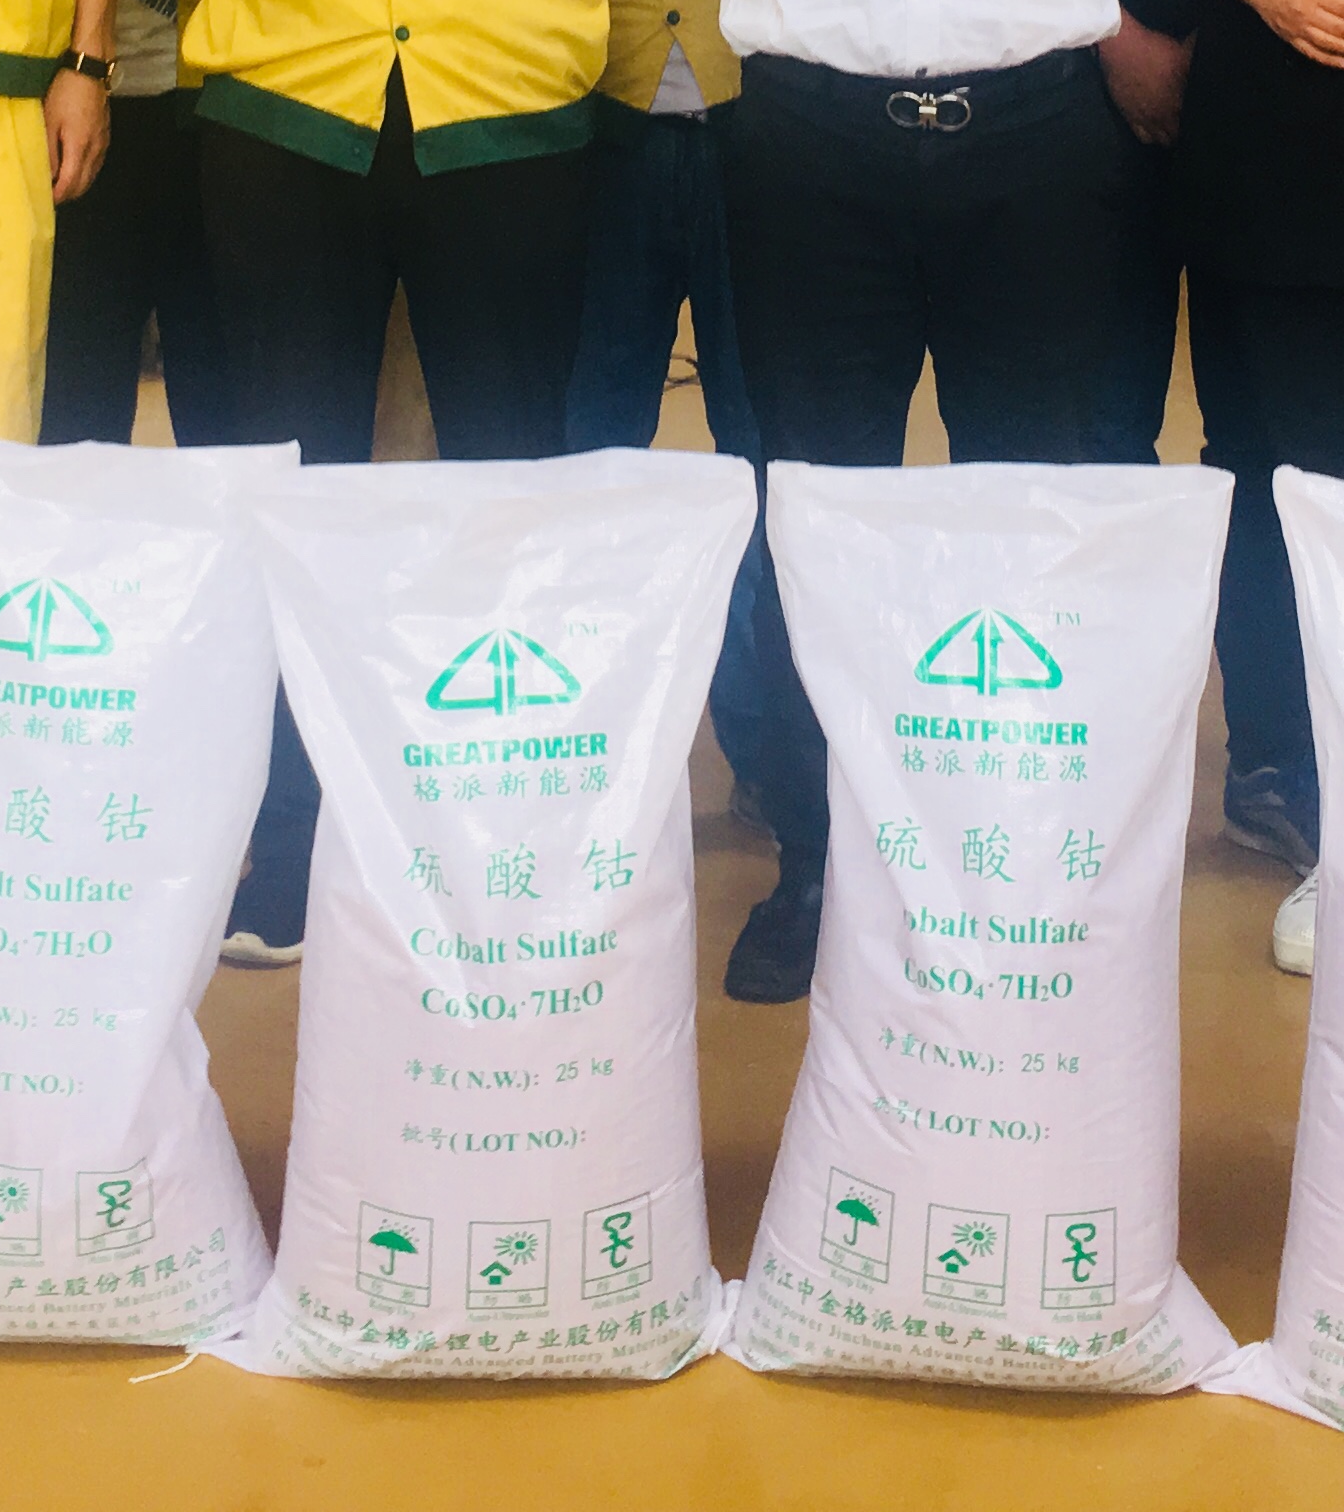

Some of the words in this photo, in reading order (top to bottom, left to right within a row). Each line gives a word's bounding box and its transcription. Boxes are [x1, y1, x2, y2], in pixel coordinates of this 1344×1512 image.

[894, 712, 1089, 746] GREATPOWER
[403, 732, 608, 767] GREATPOWER
[900, 743, 1089, 783] 格派新能源
[413, 764, 611, 803] 格派新能源
[875, 816, 1106, 883] 硫酸钴
[402, 838, 638, 900] 硫酸钴
[23, 873, 134, 902] Sulfate
[410, 927, 508, 964] Cobalt
[516, 929, 619, 962] Sulfate
[988, 914, 1090, 944] Sulfate
[53, 1007, 80, 1027] 25
[92, 1007, 118, 1032] kg
[555, 1060, 579, 1083] 25
[591, 1057, 614, 1076] kg
[1020, 1053, 1046, 1073] 25
[1056, 1052, 1080, 1074] kg
